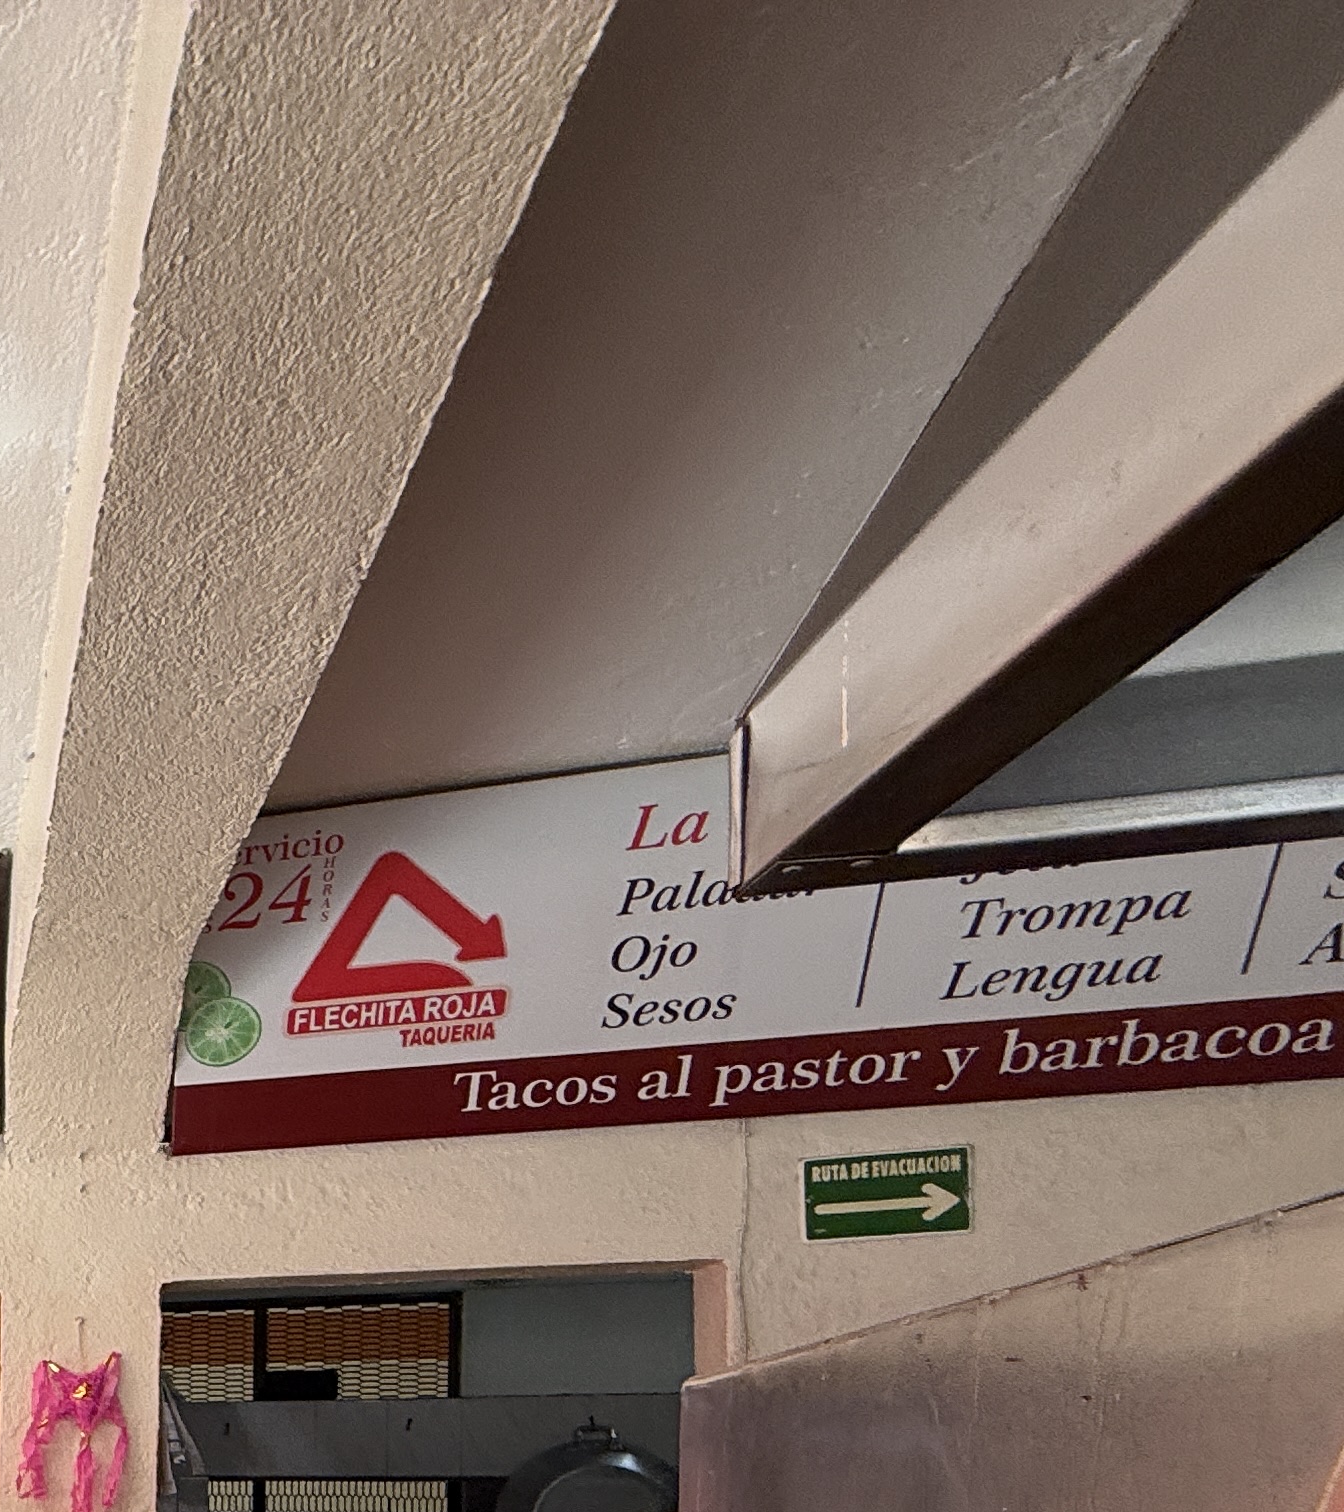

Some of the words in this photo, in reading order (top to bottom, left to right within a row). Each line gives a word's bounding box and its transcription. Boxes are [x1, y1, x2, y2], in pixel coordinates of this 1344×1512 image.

[236, 829, 344, 866] rvicio
[625, 803, 710, 851] La
[218, 863, 312, 931] 24
[320, 856, 337, 922] HORAS
[960, 889, 1192, 939] Trompa
[611, 933, 698, 980] Ojo
[939, 953, 1164, 1001] Lengua
[293, 999, 416, 1033] FLECHITA
[423, 992, 497, 1020] ROJA
[601, 993, 737, 1029] Sesos
[399, 1022, 496, 1048] TAQUERIA
[452, 1070, 618, 1113] Tacos
[637, 1054, 693, 1101] al
[709, 1046, 921, 1107] pastor
[935, 1045, 980, 1092] y
[998, 1017, 1336, 1075] barbacoa
[812, 1164, 849, 1182] RUTA
[851, 1161, 869, 1179] DE
[871, 1154, 961, 1178] EVACUACION
